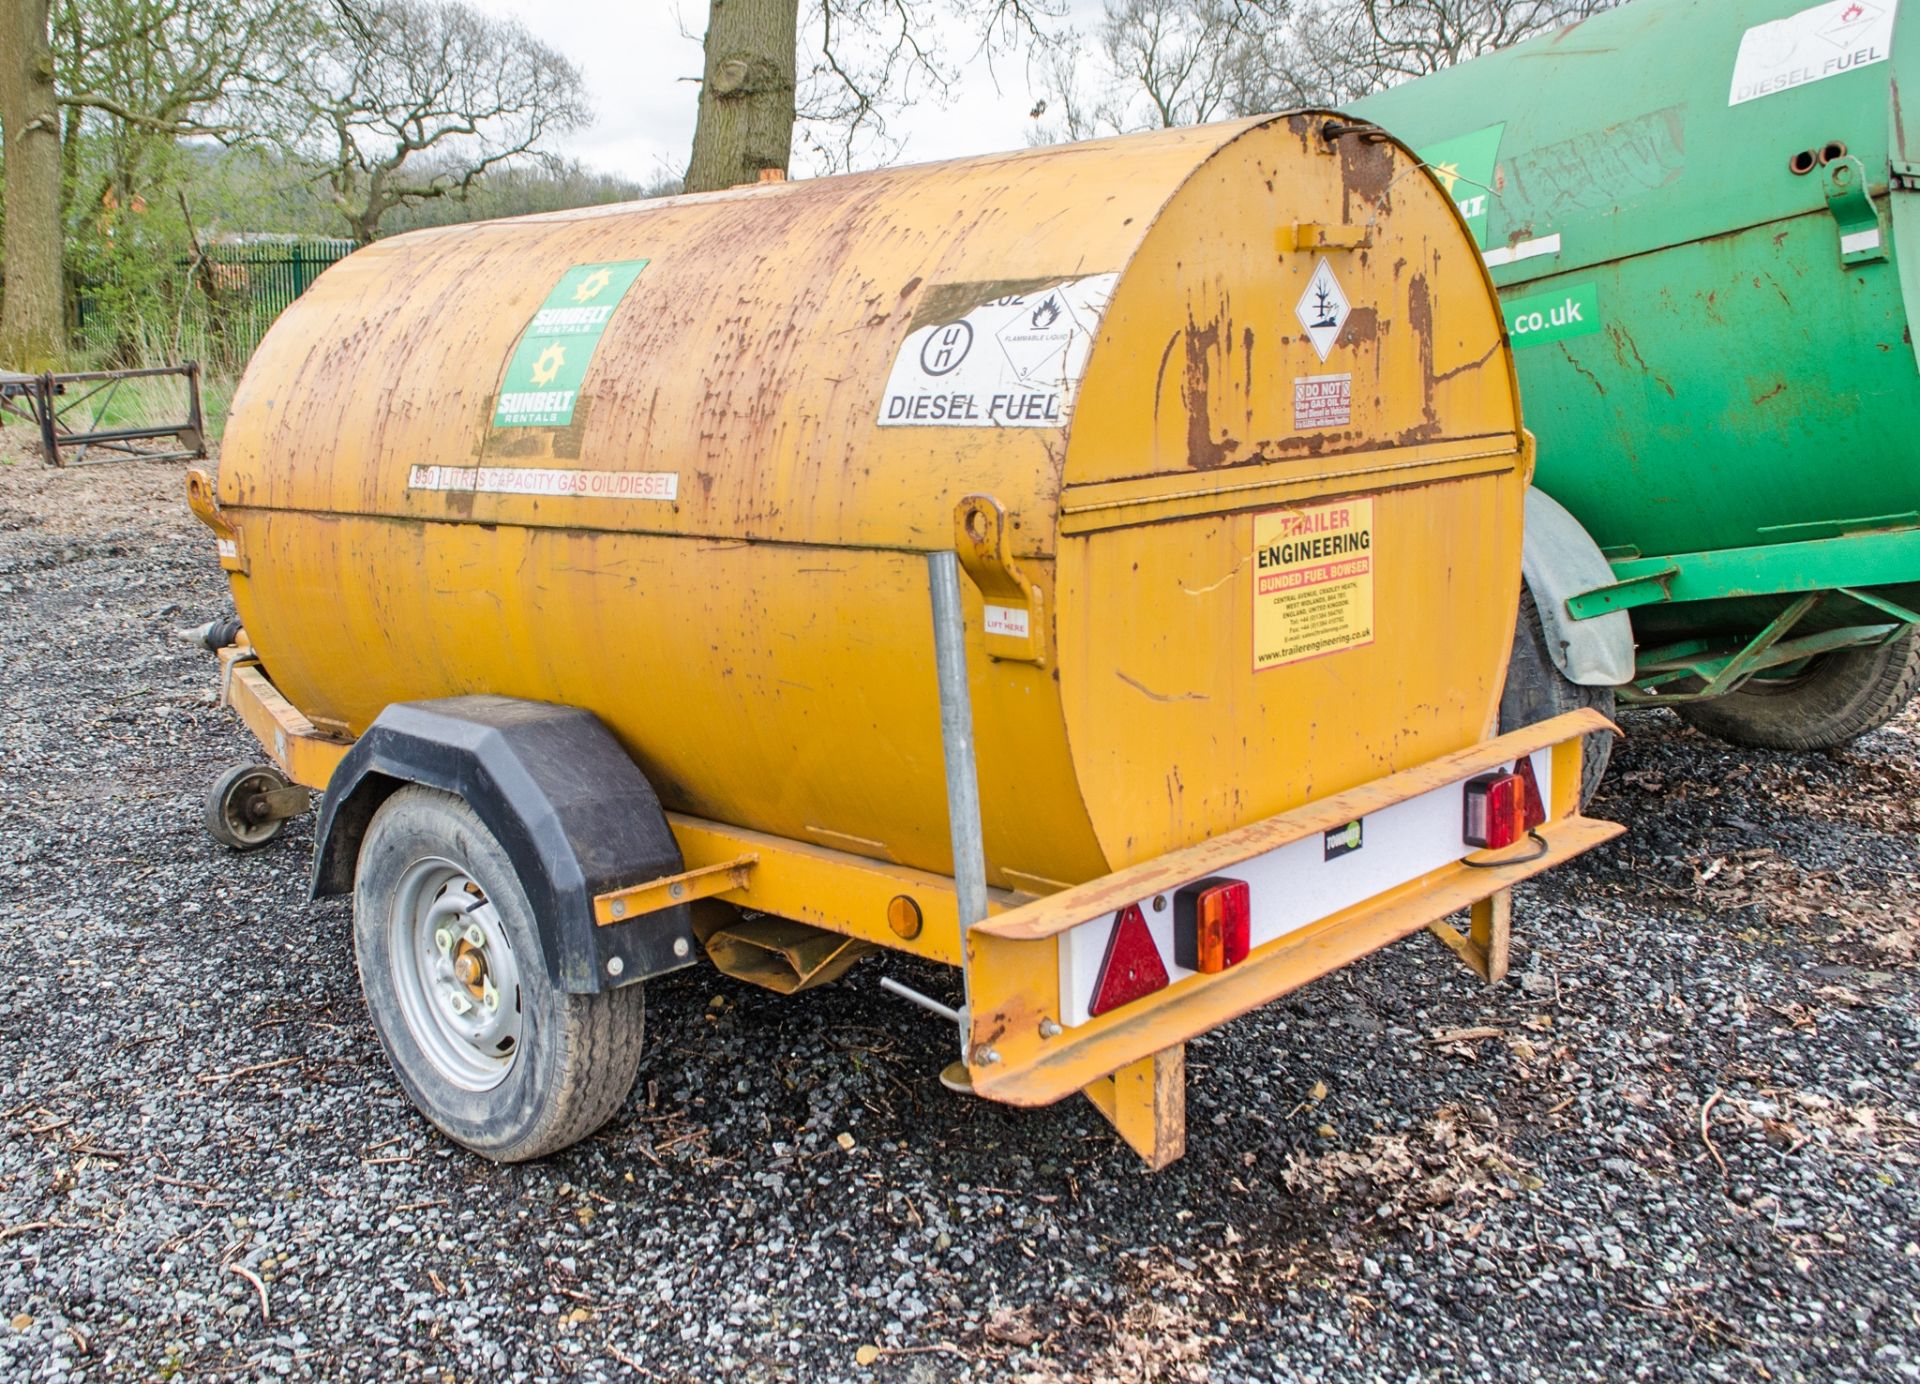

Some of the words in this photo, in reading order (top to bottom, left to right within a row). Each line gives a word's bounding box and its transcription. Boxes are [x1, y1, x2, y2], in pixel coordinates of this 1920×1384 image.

[1737, 66, 1815, 101] DIESEL
[1823, 46, 1881, 75] FUEL
[532, 304, 613, 326] SUNBELT
[536, 323, 592, 334] RENTALS
[1020, 366, 1028, 377] 3
[1305, 383, 1319, 397] DO
[1321, 382, 1340, 396] NOT
[498, 390, 575, 414] SUNBELT
[888, 394, 978, 420] DIESEL
[988, 393, 1059, 420] FUEL
[1311, 399, 1326, 409] GAS
[1327, 398, 1339, 407] OIL
[504, 412, 558, 423] RENTALS
[442, 470, 486, 488] LITRES
[488, 471, 554, 490] CAPACITY
[557, 472, 588, 492] GAS
[592, 474, 674, 496] OIL/DIESEL
[1280, 509, 1350, 537] TRAILER
[1258, 530, 1370, 568] ENGINEERING
[1260, 571, 1302, 592] BUNDED
[1304, 568, 1328, 585] FUEL
[1331, 560, 1369, 577] BOWSER
[987, 620, 1002, 628] LIFT
[1004, 623, 1025, 633] HERE
[1258, 628, 1371, 663] www.trailerengineering.co.uk
